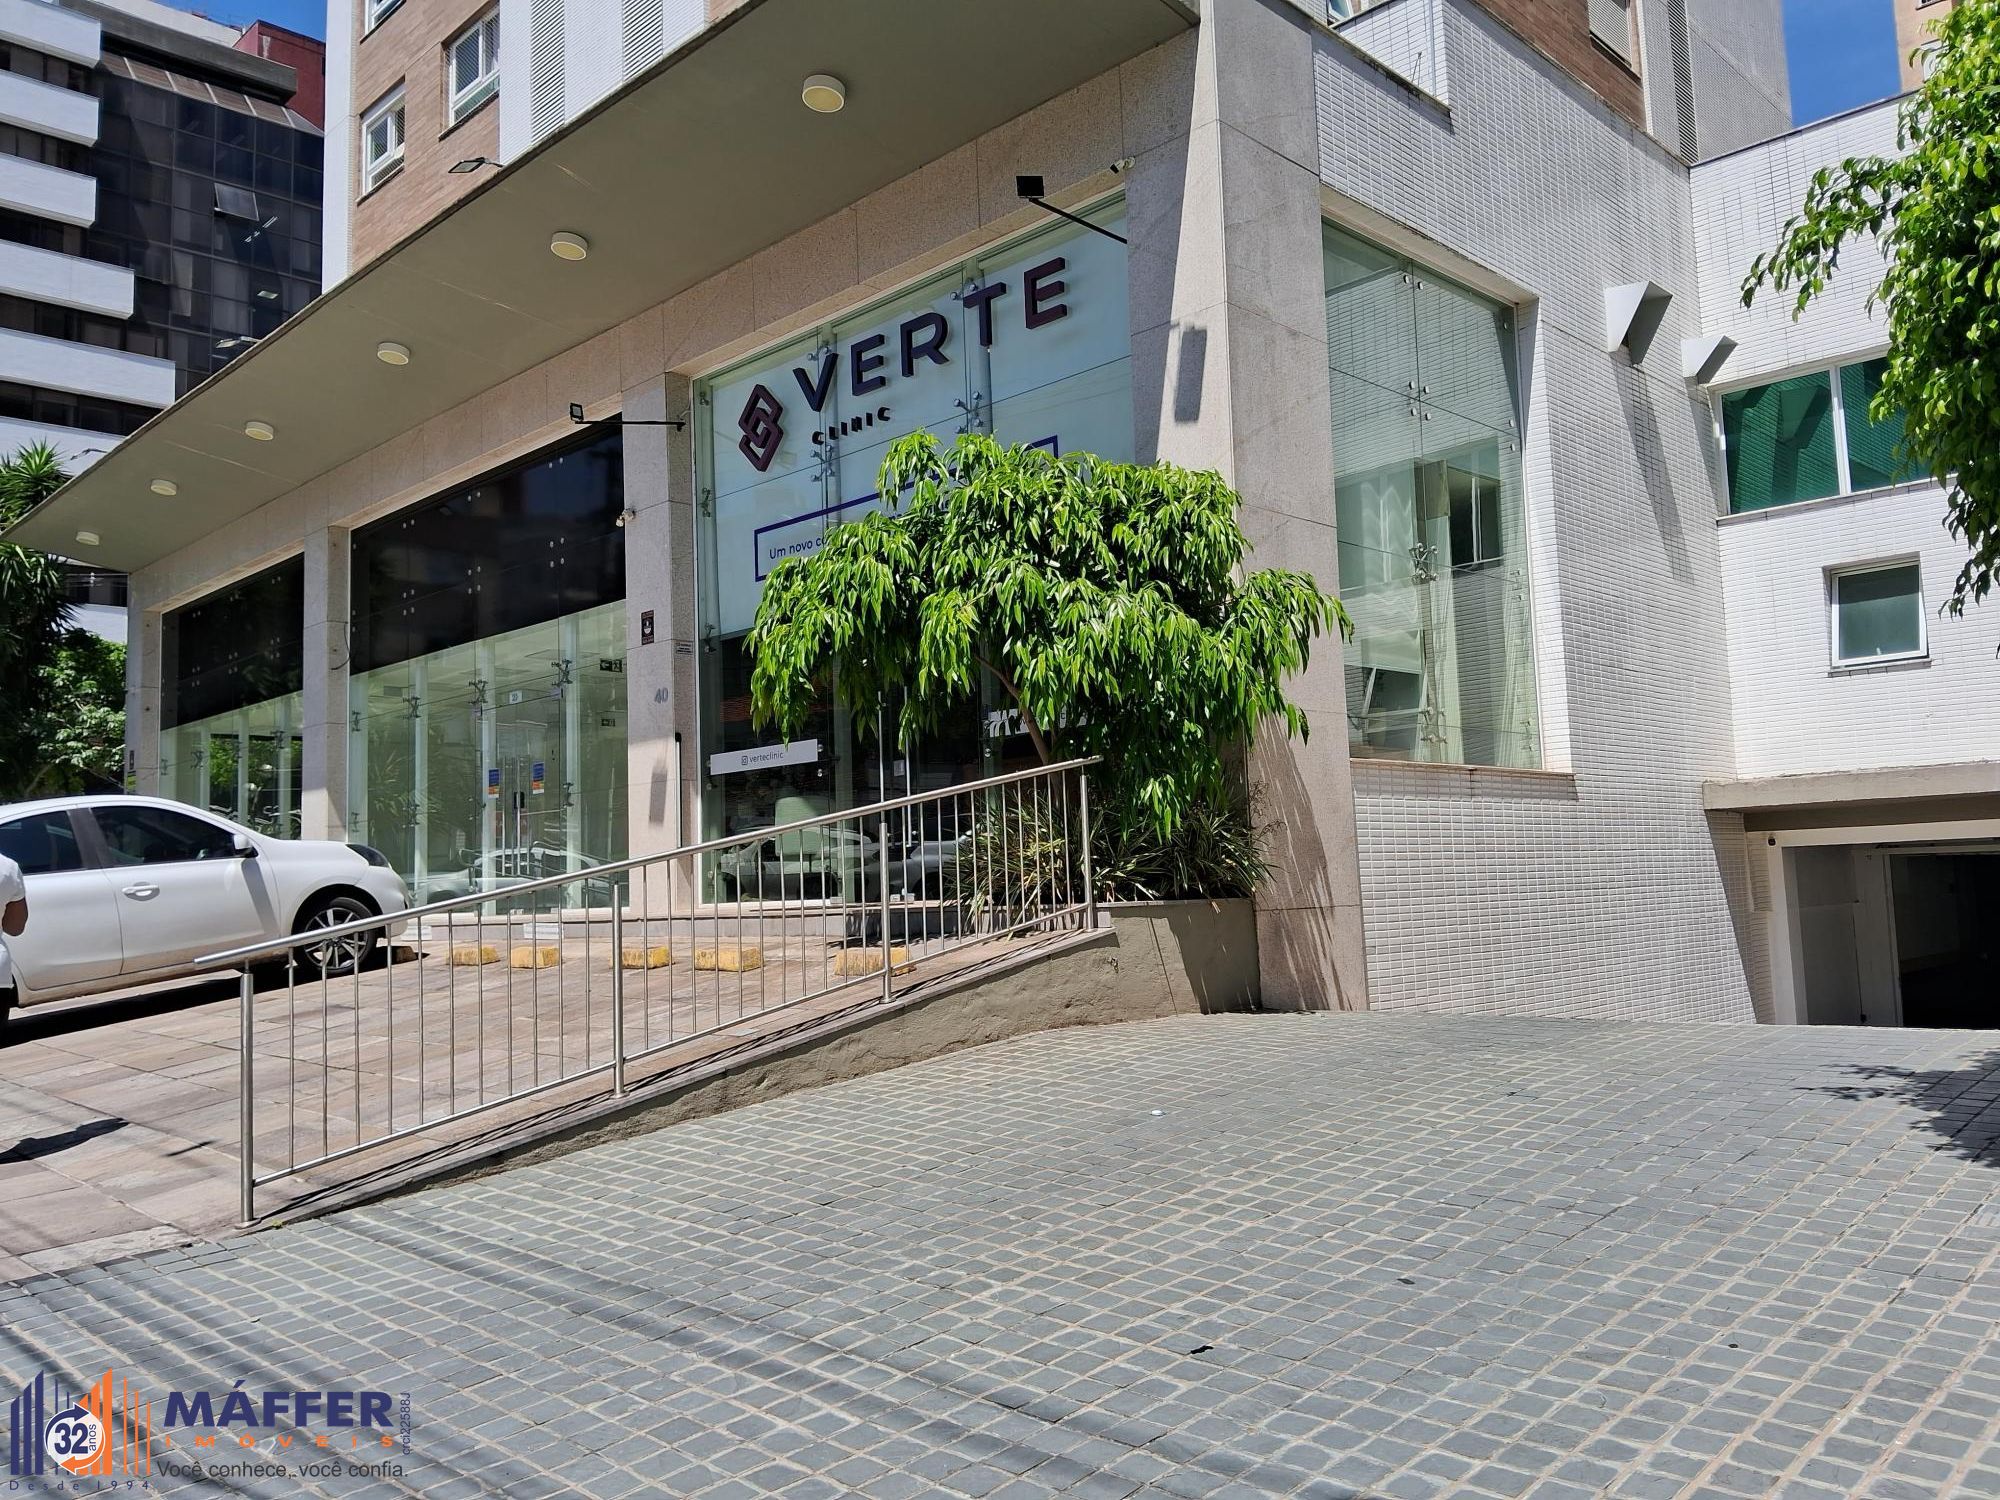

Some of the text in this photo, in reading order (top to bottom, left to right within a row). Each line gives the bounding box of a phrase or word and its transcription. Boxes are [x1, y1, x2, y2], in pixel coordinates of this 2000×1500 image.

[793, 257, 1068, 413] VERTE
[812, 406, 891, 446] CLINIC
[769, 547, 786, 560] Um
[789, 540, 813, 554] novo
[654, 687, 669, 704] 40
